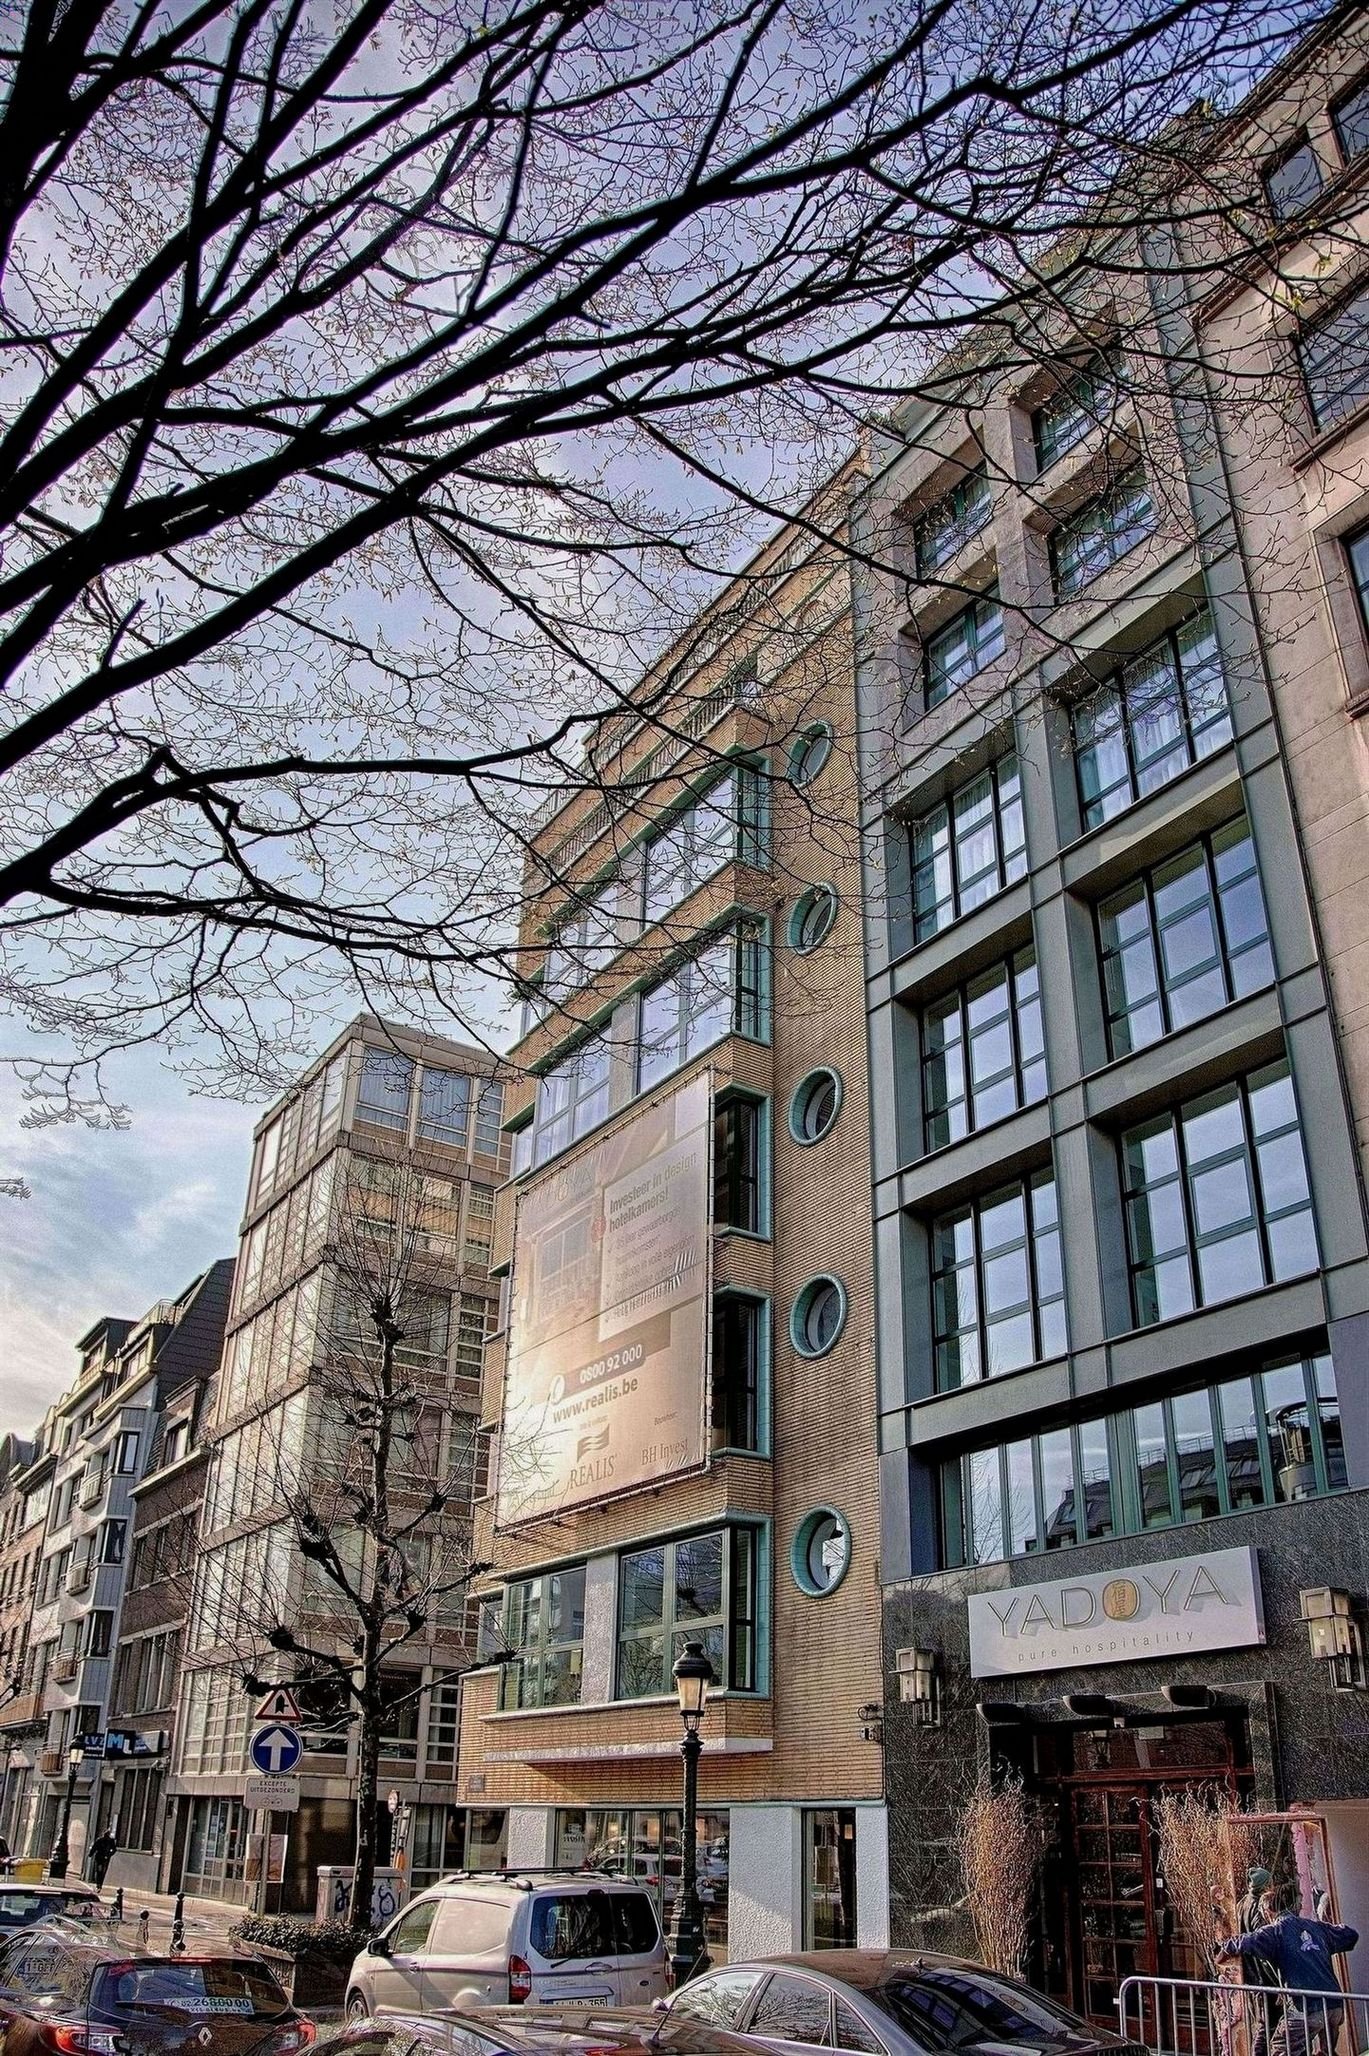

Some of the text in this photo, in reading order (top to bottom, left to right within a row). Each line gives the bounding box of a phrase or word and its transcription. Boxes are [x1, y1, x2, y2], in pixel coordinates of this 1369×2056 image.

[609, 1180, 651, 1214] Investeer
[652, 1173, 662, 1189] in
[664, 1152, 697, 1181] design
[609, 1185, 669, 1233] hotelkamers!
[580, 1343, 643, 1384] 0800 92 000
[553, 1377, 639, 1423] www.realis.be
[570, 1455, 616, 1489] REALIS
[641, 1438, 688, 1465] BH Invest
[986, 1564, 1229, 1637] YADOYA
[1018, 1629, 1195, 1664] pure hospitality
